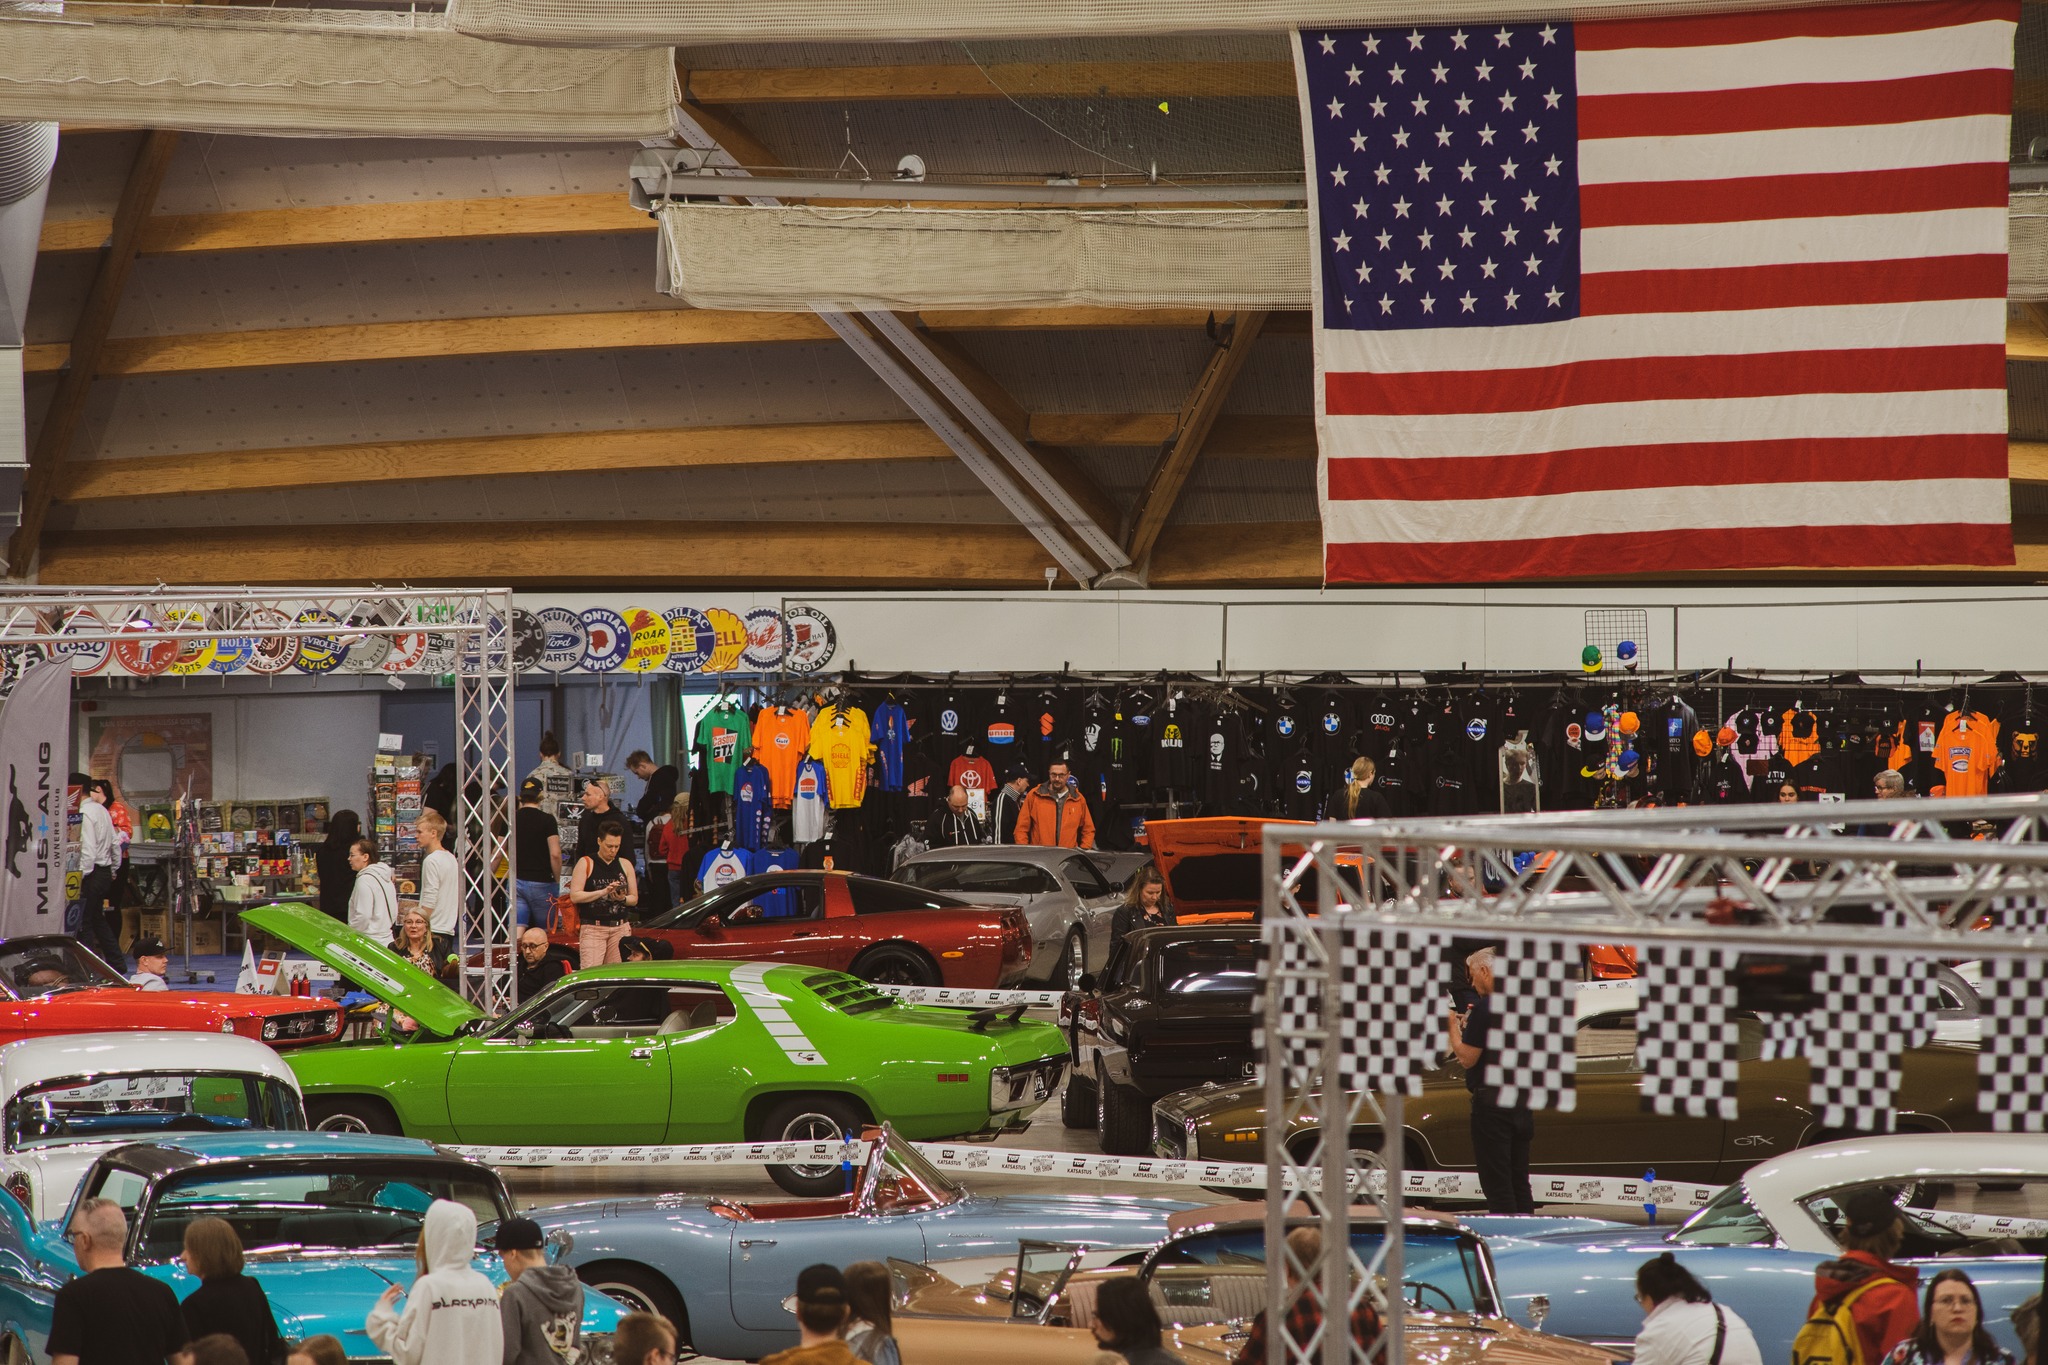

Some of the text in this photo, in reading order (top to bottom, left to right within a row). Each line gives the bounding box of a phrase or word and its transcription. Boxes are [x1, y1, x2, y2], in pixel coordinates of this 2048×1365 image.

[513, 610, 543, 640] ORD
[543, 611, 582, 633] NUINE
[583, 610, 627, 635] ONTIAC
[665, 607, 709, 629] DILLAC
[810, 611, 829, 627] OIL
[427, 637, 456, 648] VROLET
[546, 632, 572, 647] Ford
[633, 628, 666, 641] ROAR
[715, 630, 742, 647] ELL
[303, 635, 341, 653] EVROLET
[628, 643, 668, 659] LMORE
[119, 644, 172, 671] MUSTANG
[345, 643, 386, 668] CORETTE
[410, 645, 425, 663] OIL
[583, 652, 622, 670] RVICE
[786, 642, 835, 672] ASOLINE
[171, 661, 202, 673] PARTS
[208, 655, 249, 670] ERVICE
[299, 656, 338, 670] RVICE
[461, 659, 496, 673] PARS
[712, 734, 737, 747] Castrol
[713, 743, 734, 759] GTX
[831, 752, 851, 760] SHELL
[1734, 1135, 1774, 1146] GTX
